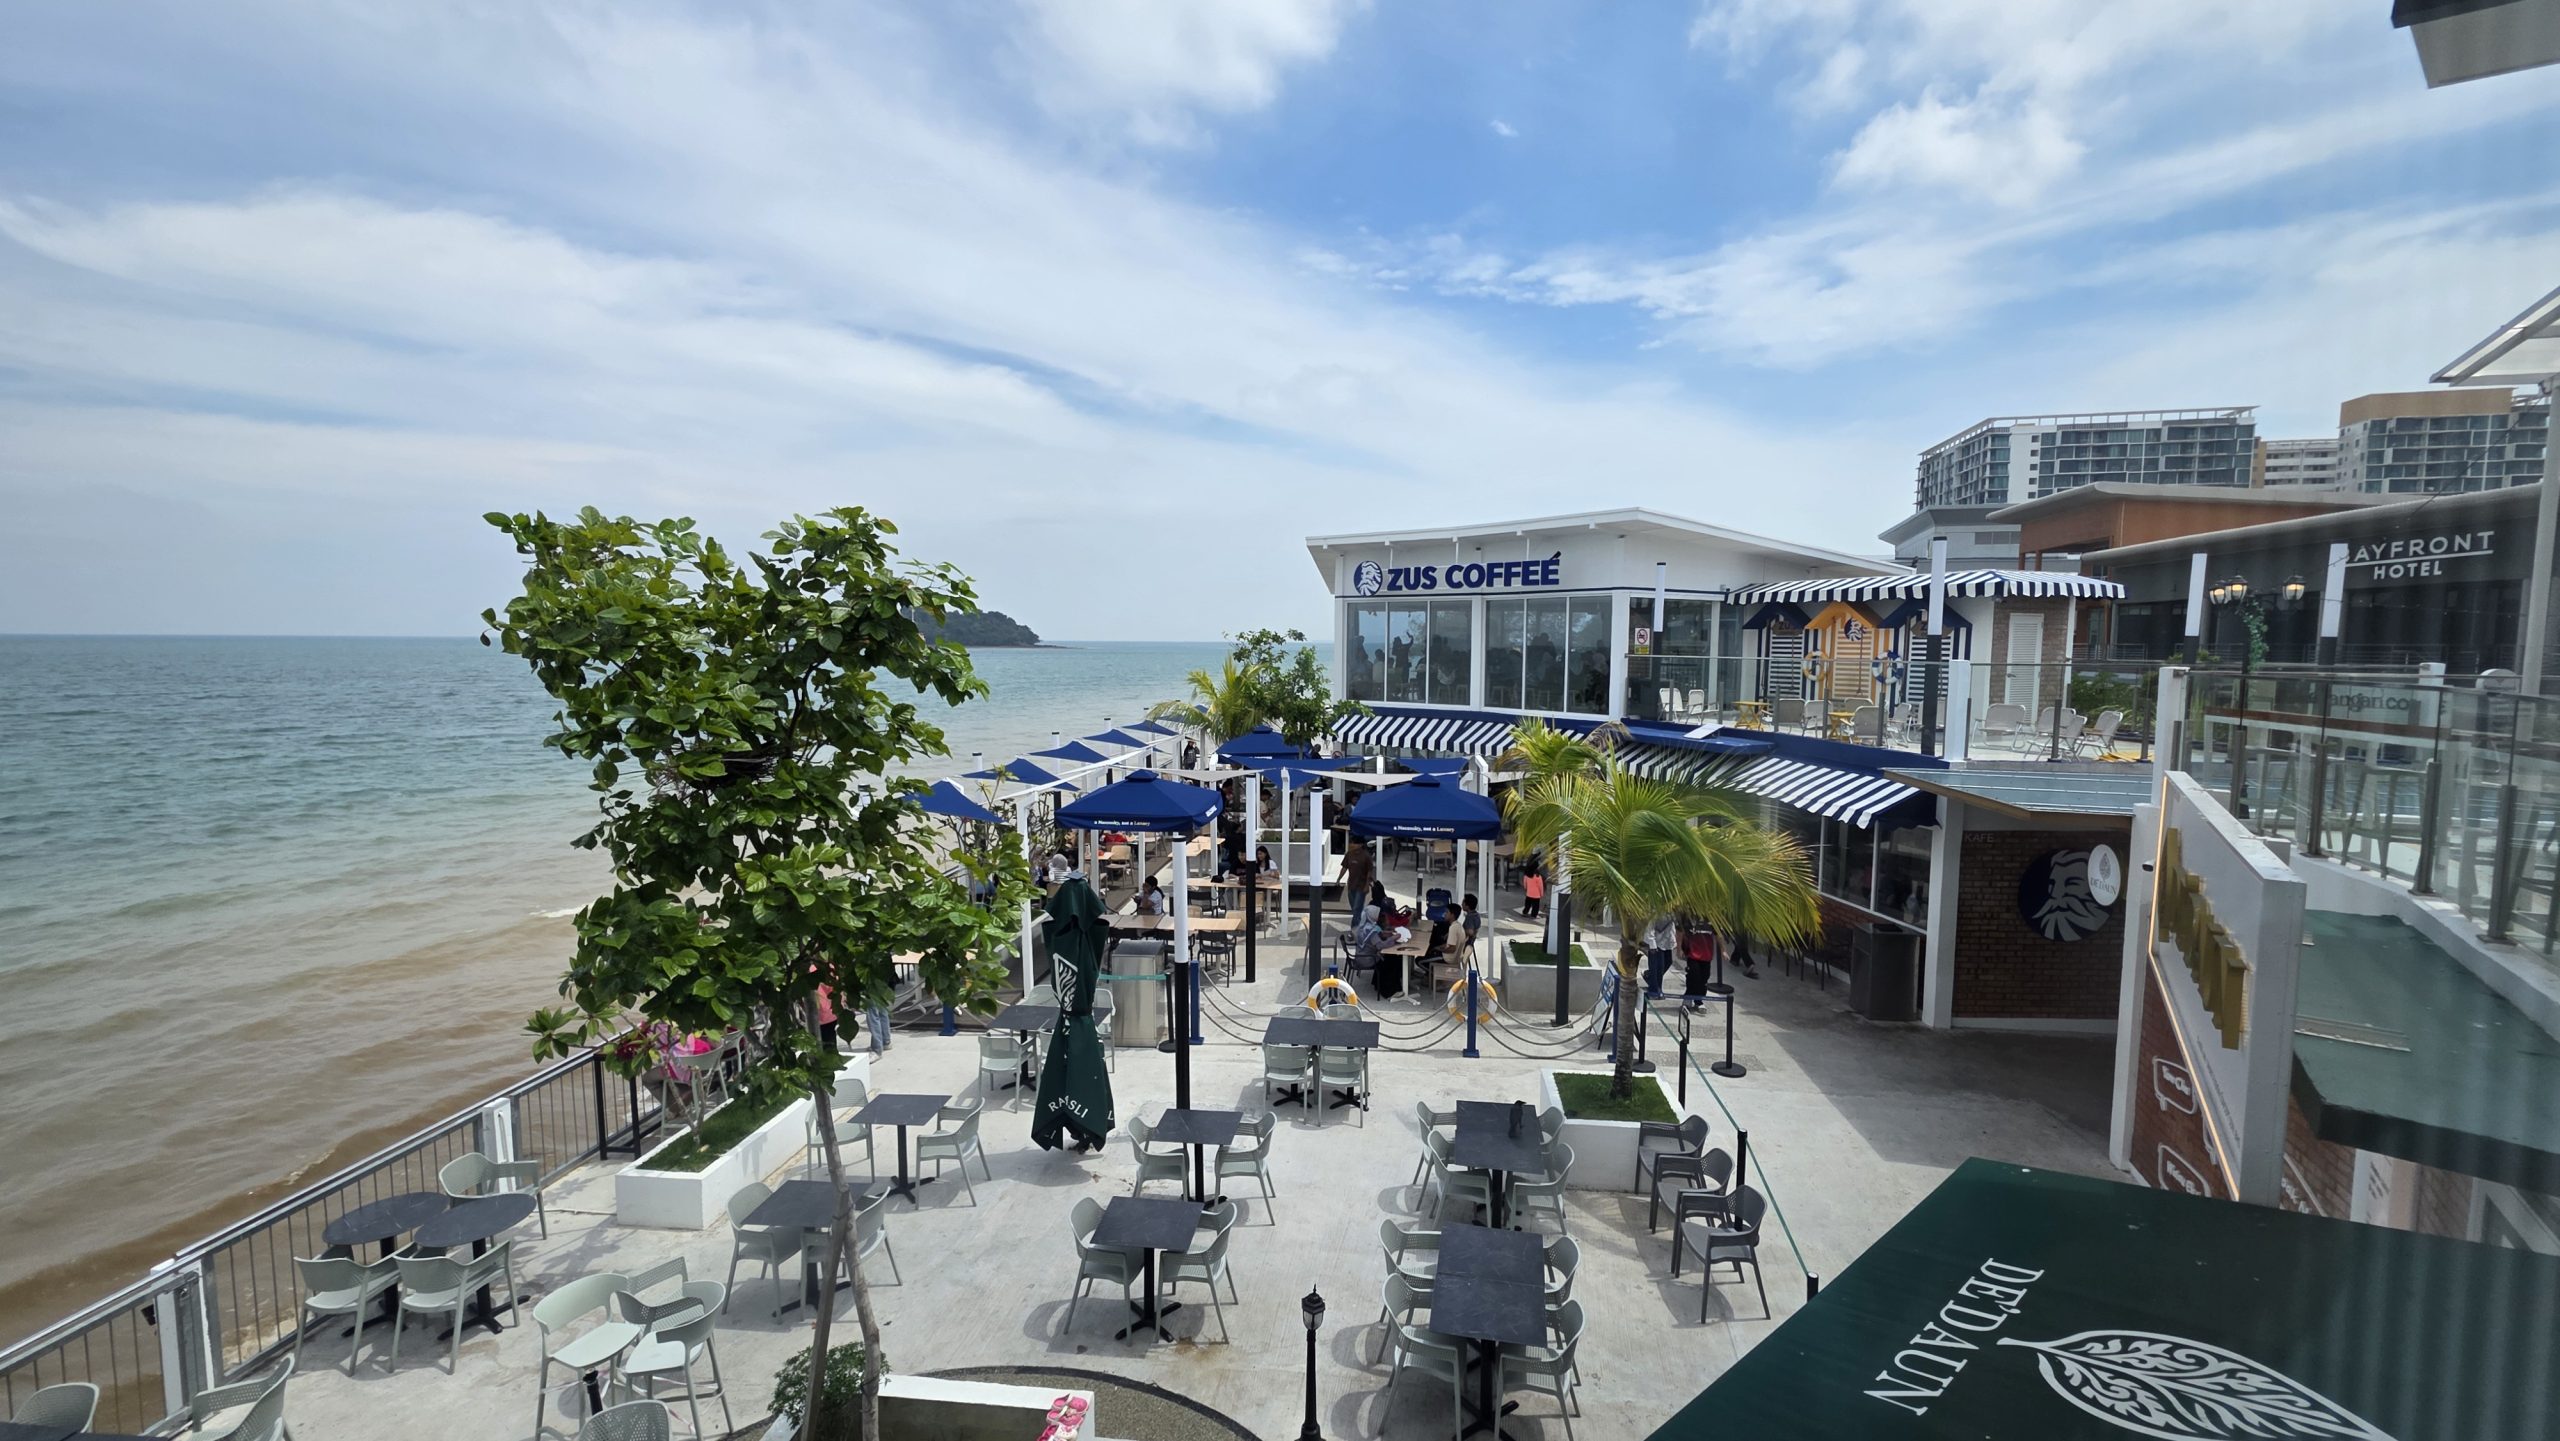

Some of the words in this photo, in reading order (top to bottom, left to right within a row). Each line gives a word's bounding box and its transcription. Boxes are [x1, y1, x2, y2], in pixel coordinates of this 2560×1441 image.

[2347, 531, 2495, 562] AYFRONT
[1387, 566, 1437, 591] ZUS
[2373, 560, 2443, 580] HOTEL
[1964, 833, 1995, 843] KAFE
[1863, 1257, 2045, 1417] DE'DAUN
